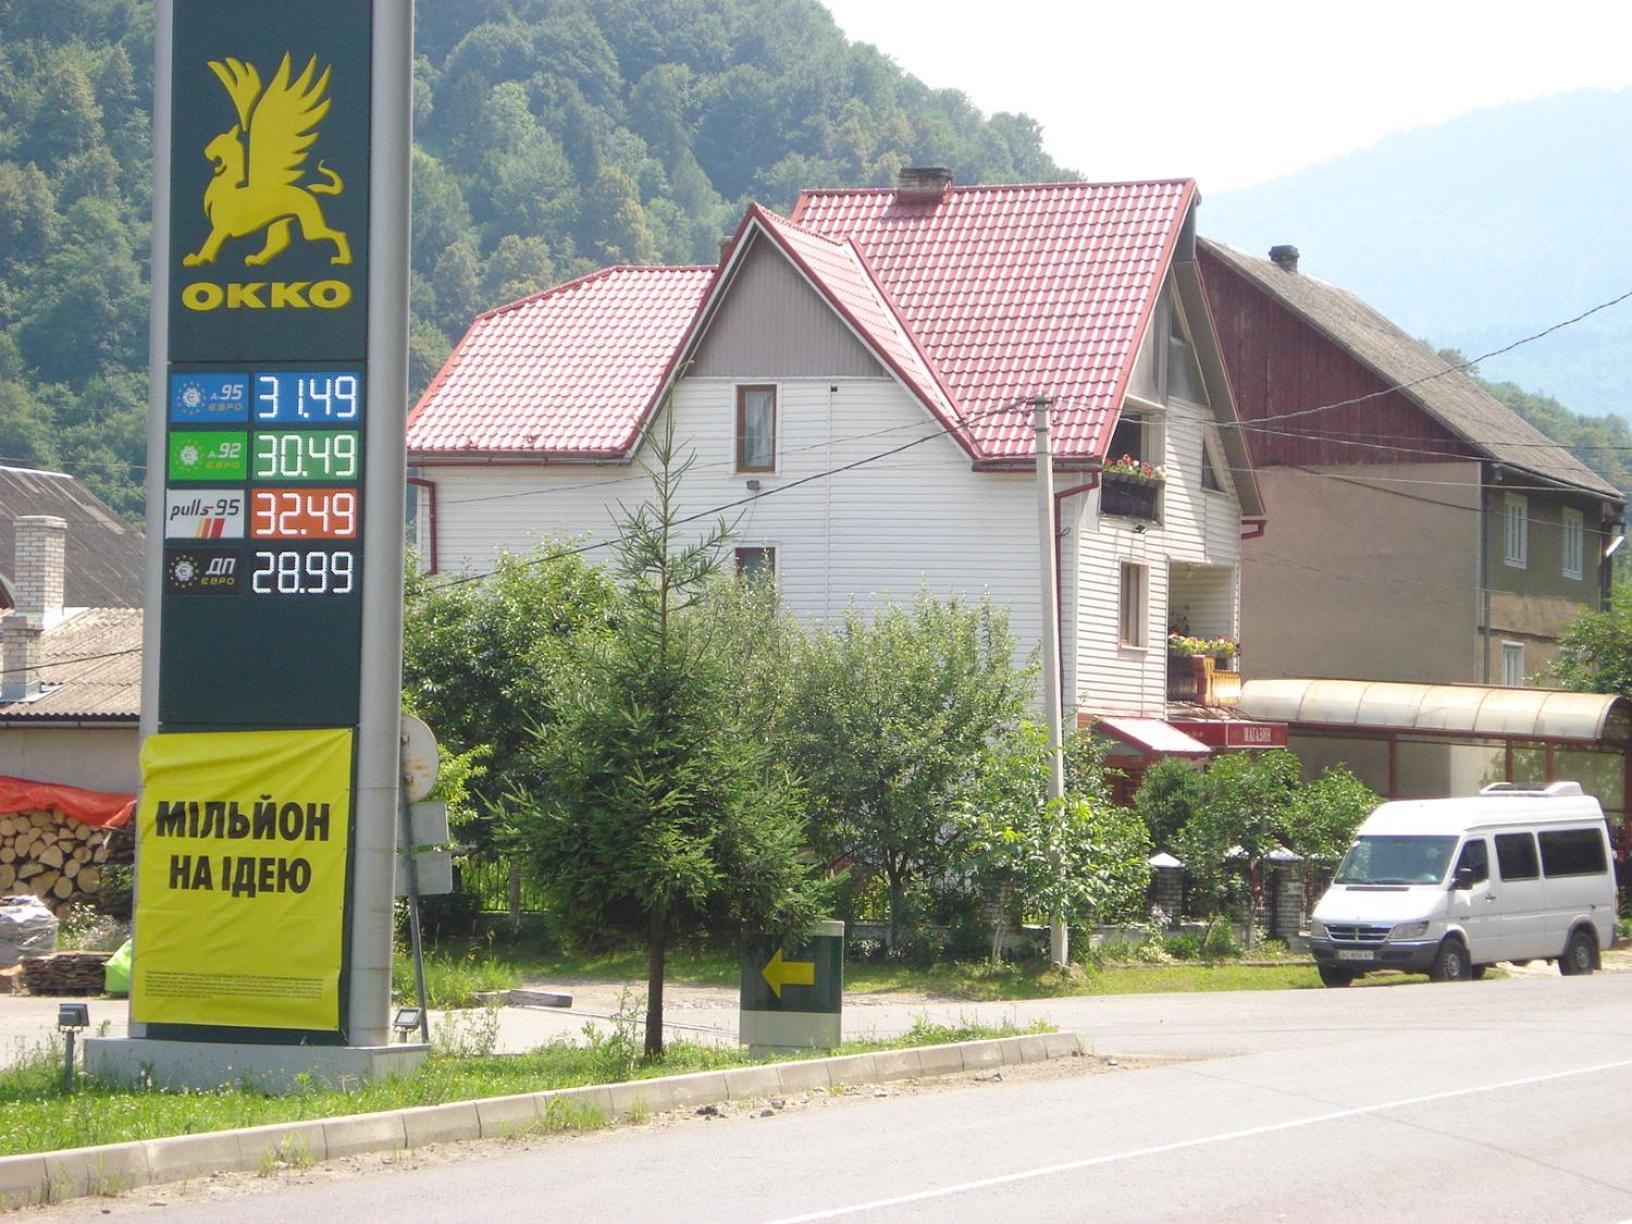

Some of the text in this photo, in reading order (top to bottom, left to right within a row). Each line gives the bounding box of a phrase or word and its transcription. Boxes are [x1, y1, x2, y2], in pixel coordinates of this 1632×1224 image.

[182, 280, 352, 311] OKKO
[258, 376, 357, 418] 31.49
[257, 435, 356, 477] 30.49
[256, 493, 354, 535] 32.49
[205, 558, 236, 575] ДП
[252, 552, 353, 594] 28.99
[1244, 727, 1272, 742] МАГАЗИН
[156, 793, 330, 841] МІЛЬЙОН
[169, 855, 312, 898] НА ІДЕЮ
